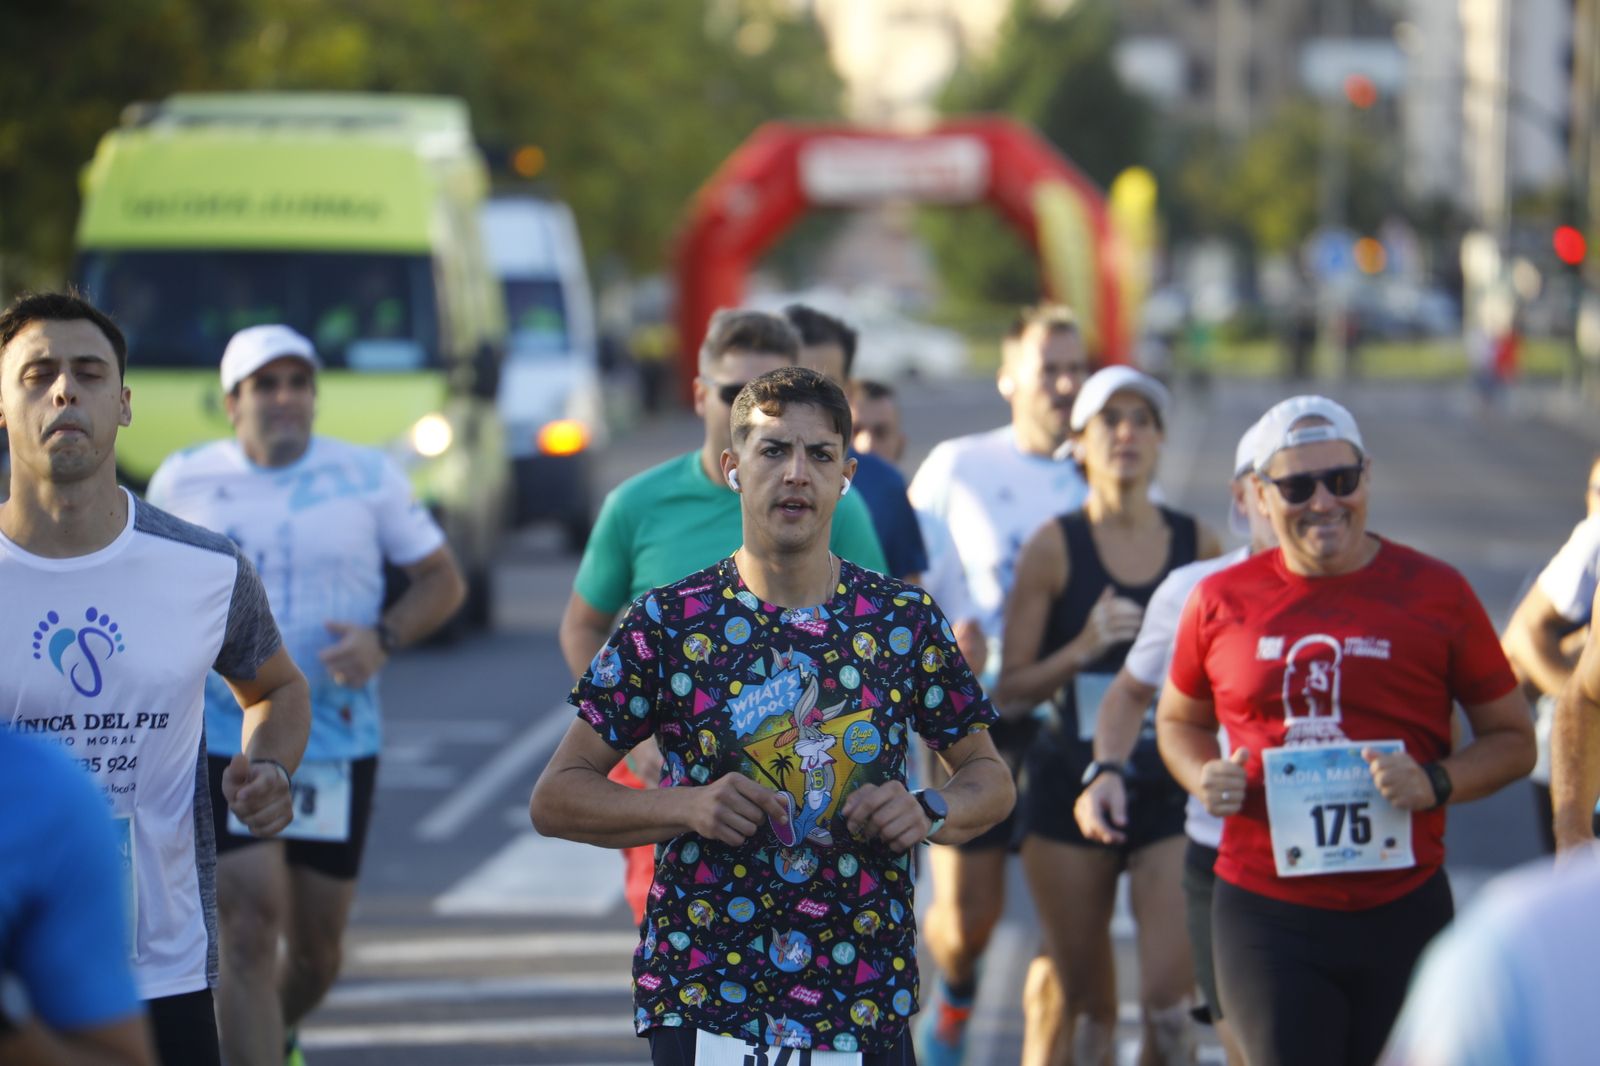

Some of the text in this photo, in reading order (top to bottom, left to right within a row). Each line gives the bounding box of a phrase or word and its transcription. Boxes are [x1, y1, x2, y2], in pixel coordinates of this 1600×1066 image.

[732, 673, 797, 714] WHAT'S
[8, 712, 169, 733] ÍNICA DEL PIE
[737, 710, 755, 728] UP
[87, 735, 136, 746] MORAL
[107, 755, 137, 773] 924
[1310, 801, 1371, 847] 175
